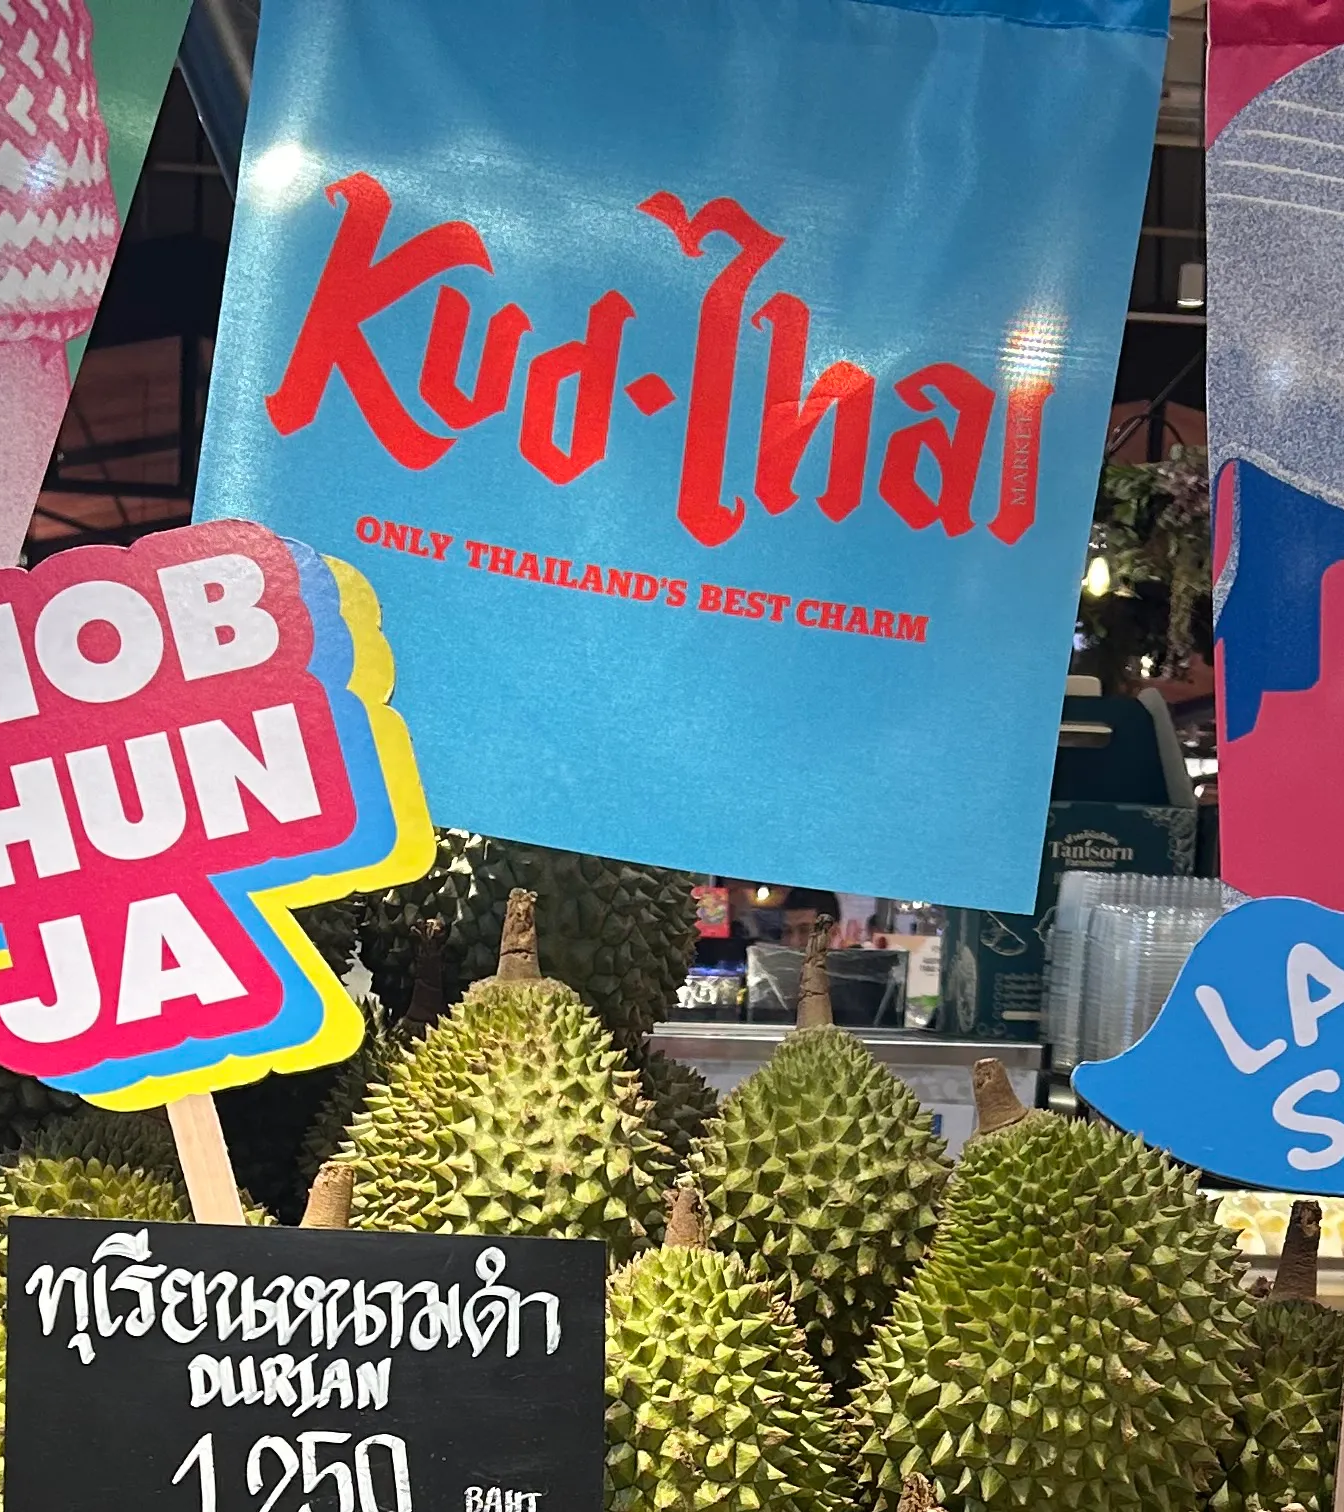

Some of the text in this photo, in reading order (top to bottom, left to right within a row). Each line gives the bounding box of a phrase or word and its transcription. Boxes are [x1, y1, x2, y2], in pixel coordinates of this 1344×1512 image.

[356, 516, 929, 645] ONLY THAILAND'S BEST CHARM
[189, 1352, 392, 1418] DURIAN
